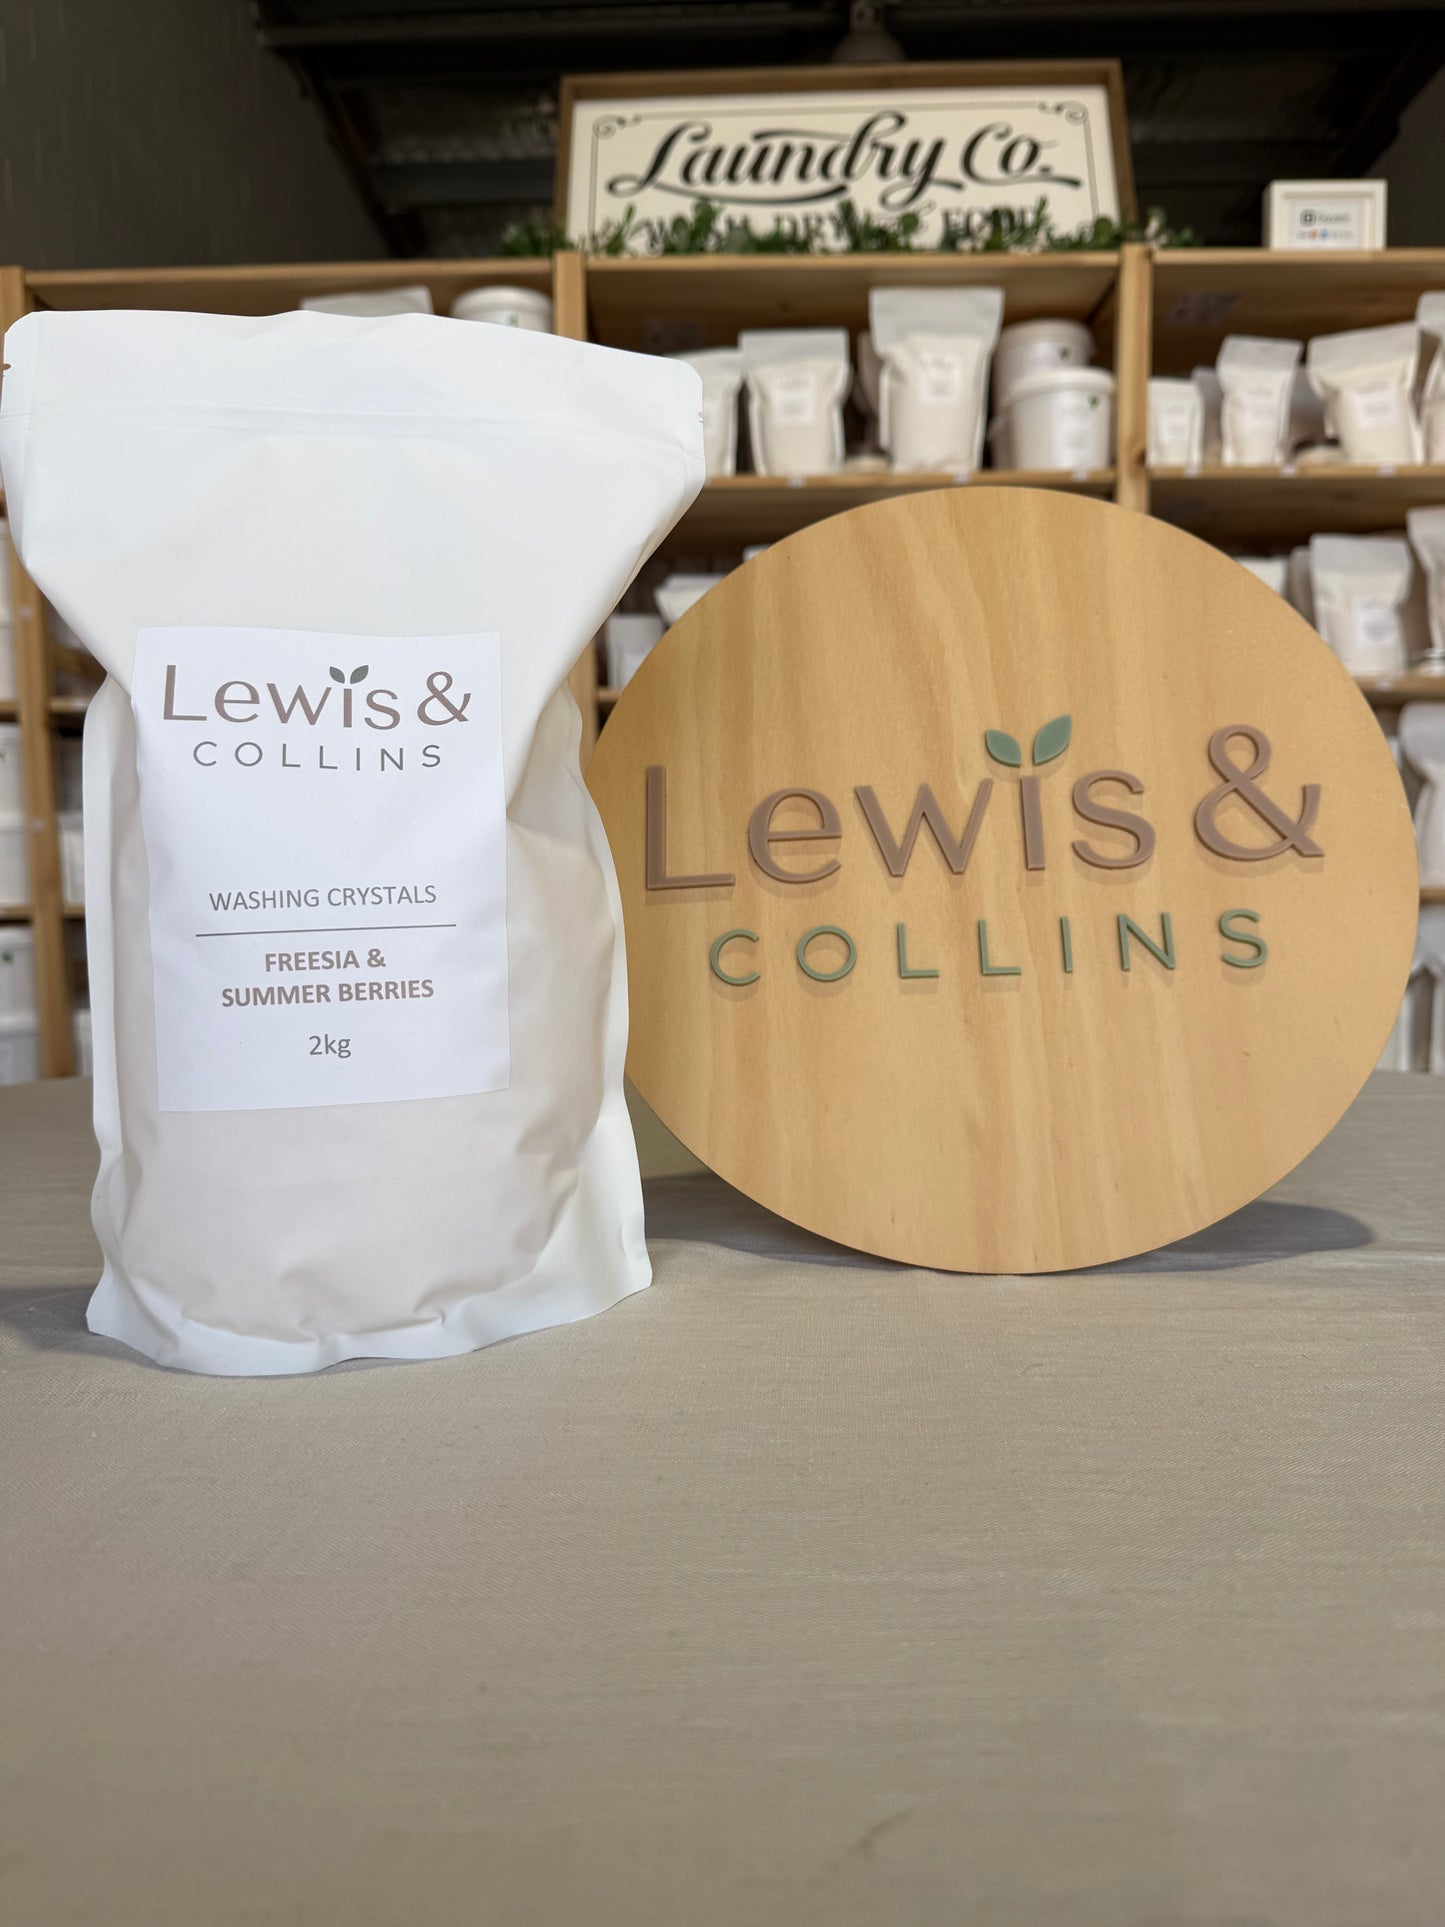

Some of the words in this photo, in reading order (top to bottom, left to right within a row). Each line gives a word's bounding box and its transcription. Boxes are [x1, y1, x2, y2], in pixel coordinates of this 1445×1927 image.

[608, 111, 963, 211] Laundry
[961, 123, 1081, 188] Co.
[163, 664, 401, 730] Lewis
[416, 670, 472, 727] &
[192, 740, 441, 772] COLLINS
[646, 762, 1155, 891] Lewis
[1194, 724, 1325, 862] &
[208, 888, 320, 912] WASHING
[327, 884, 437, 907] CRYSTALS
[264, 949, 360, 973] FREESIA
[366, 947, 387, 969] &
[709, 908, 1268, 986] COLLINS
[221, 983, 332, 1008] SUMMER
[338, 978, 434, 1003] BERRIES
[308, 1033, 352, 1058] 2kg
